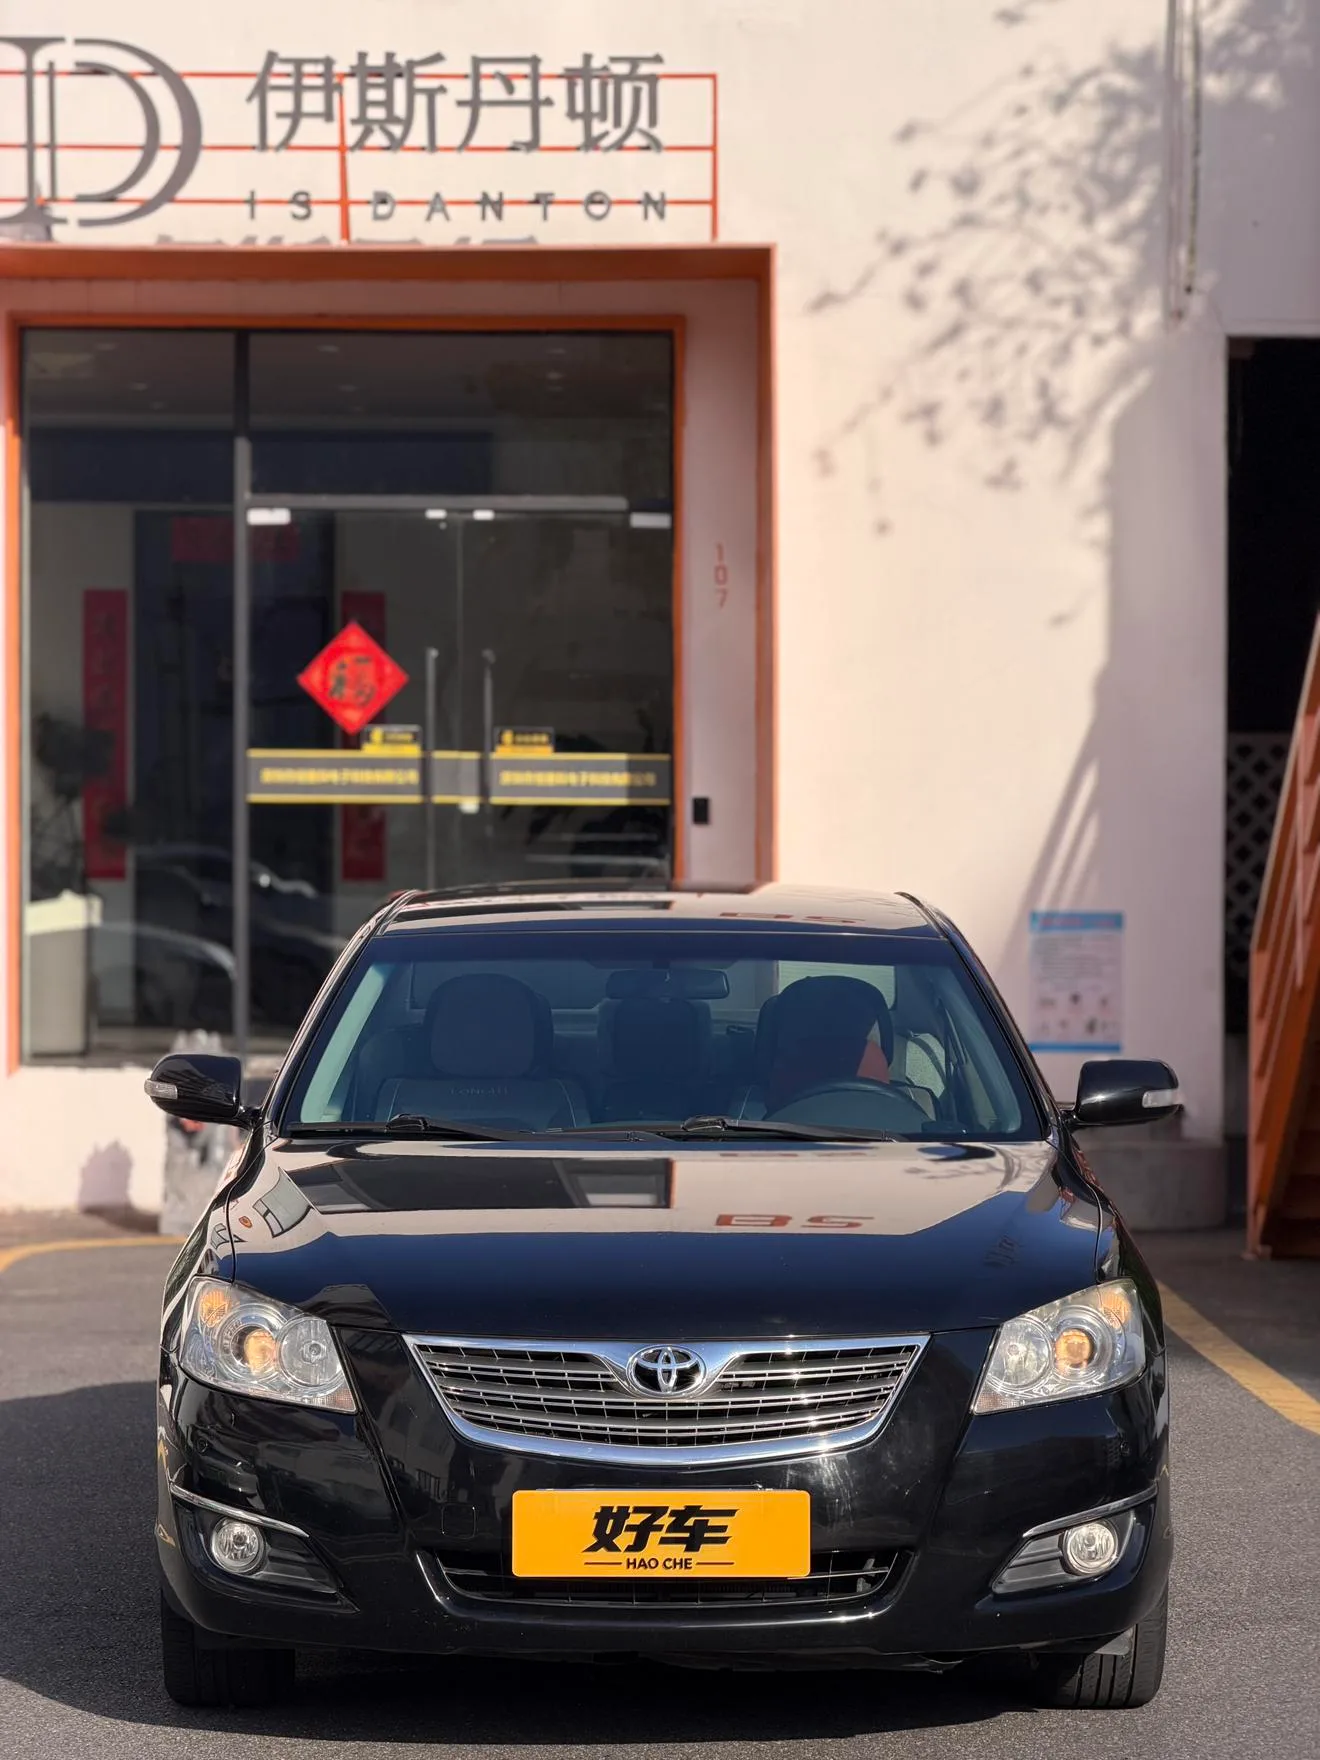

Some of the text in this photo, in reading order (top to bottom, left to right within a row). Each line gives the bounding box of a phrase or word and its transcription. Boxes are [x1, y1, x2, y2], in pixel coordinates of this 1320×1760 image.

[246, 50, 664, 153] 伊斯丹顿
[371, 189, 667, 222] DANTON
[582, 1505, 740, 1553] 好车
[625, 1557, 693, 1570] HAO CHE
